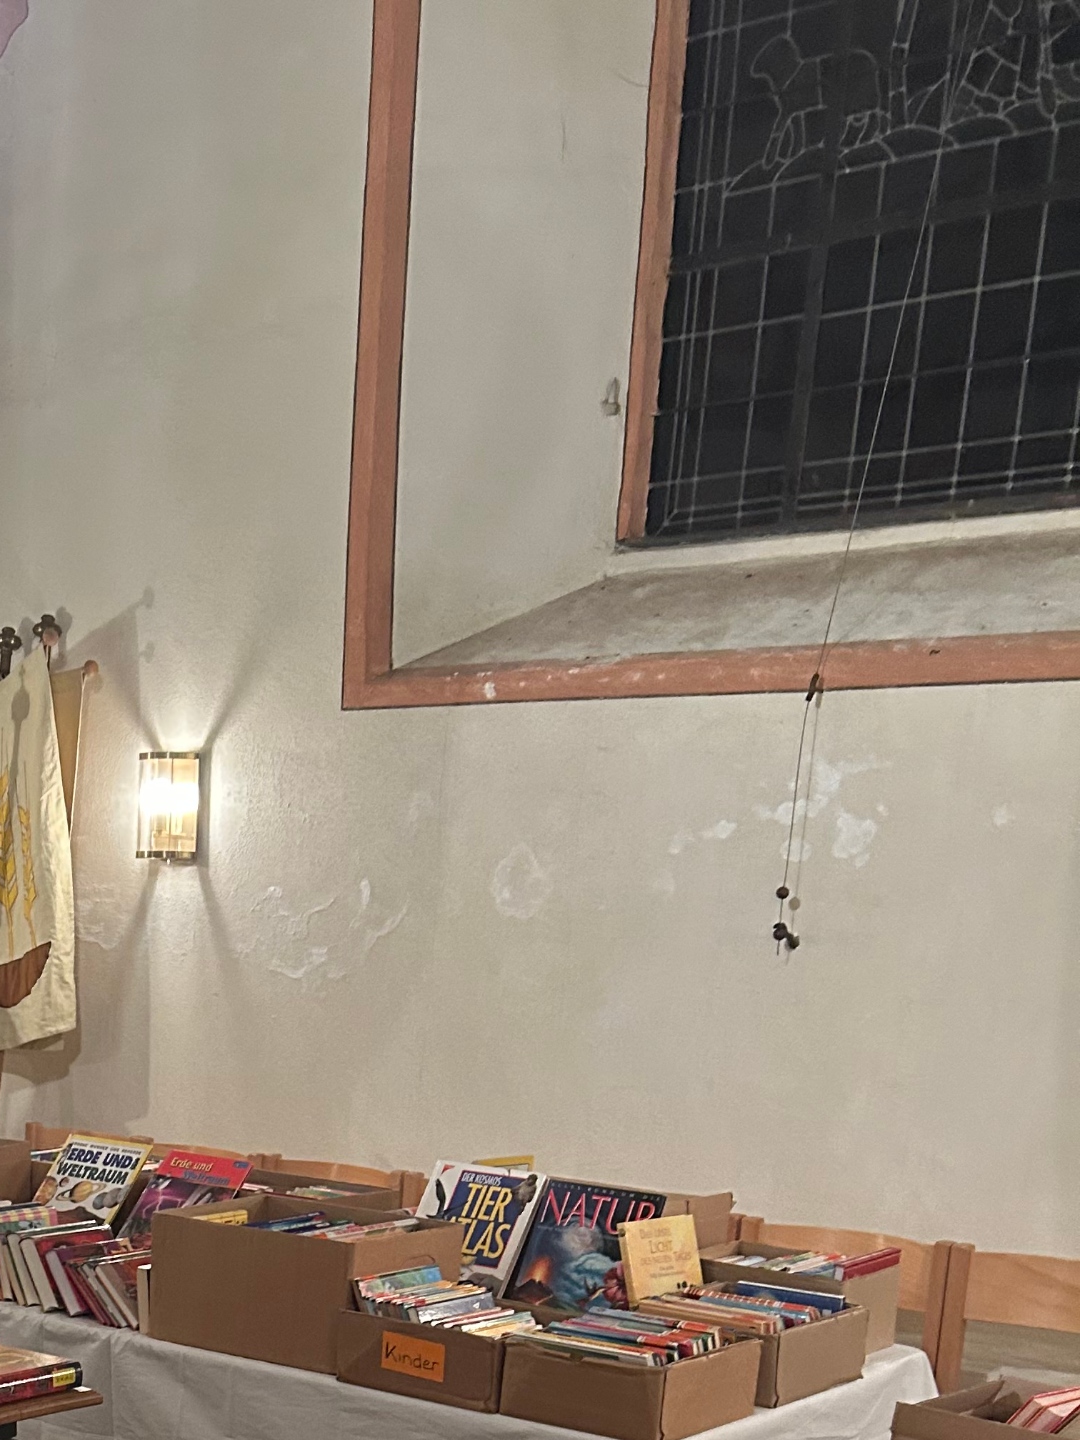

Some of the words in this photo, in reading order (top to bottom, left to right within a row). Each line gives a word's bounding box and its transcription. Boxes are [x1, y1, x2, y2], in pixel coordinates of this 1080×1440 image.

[67, 1148, 102, 1165] ERDE
[103, 1153, 133, 1169] UND
[171, 1157, 193, 1169] Erde
[194, 1161, 213, 1172] und
[58, 1162, 129, 1185] WELTRAUM
[461, 1172, 475, 1183] DER
[474, 1174, 503, 1186] KOSMOS
[460, 1183, 513, 1223] TIER
[449, 1216, 512, 1259] LAS
[385, 1342, 439, 1371] Kinder
